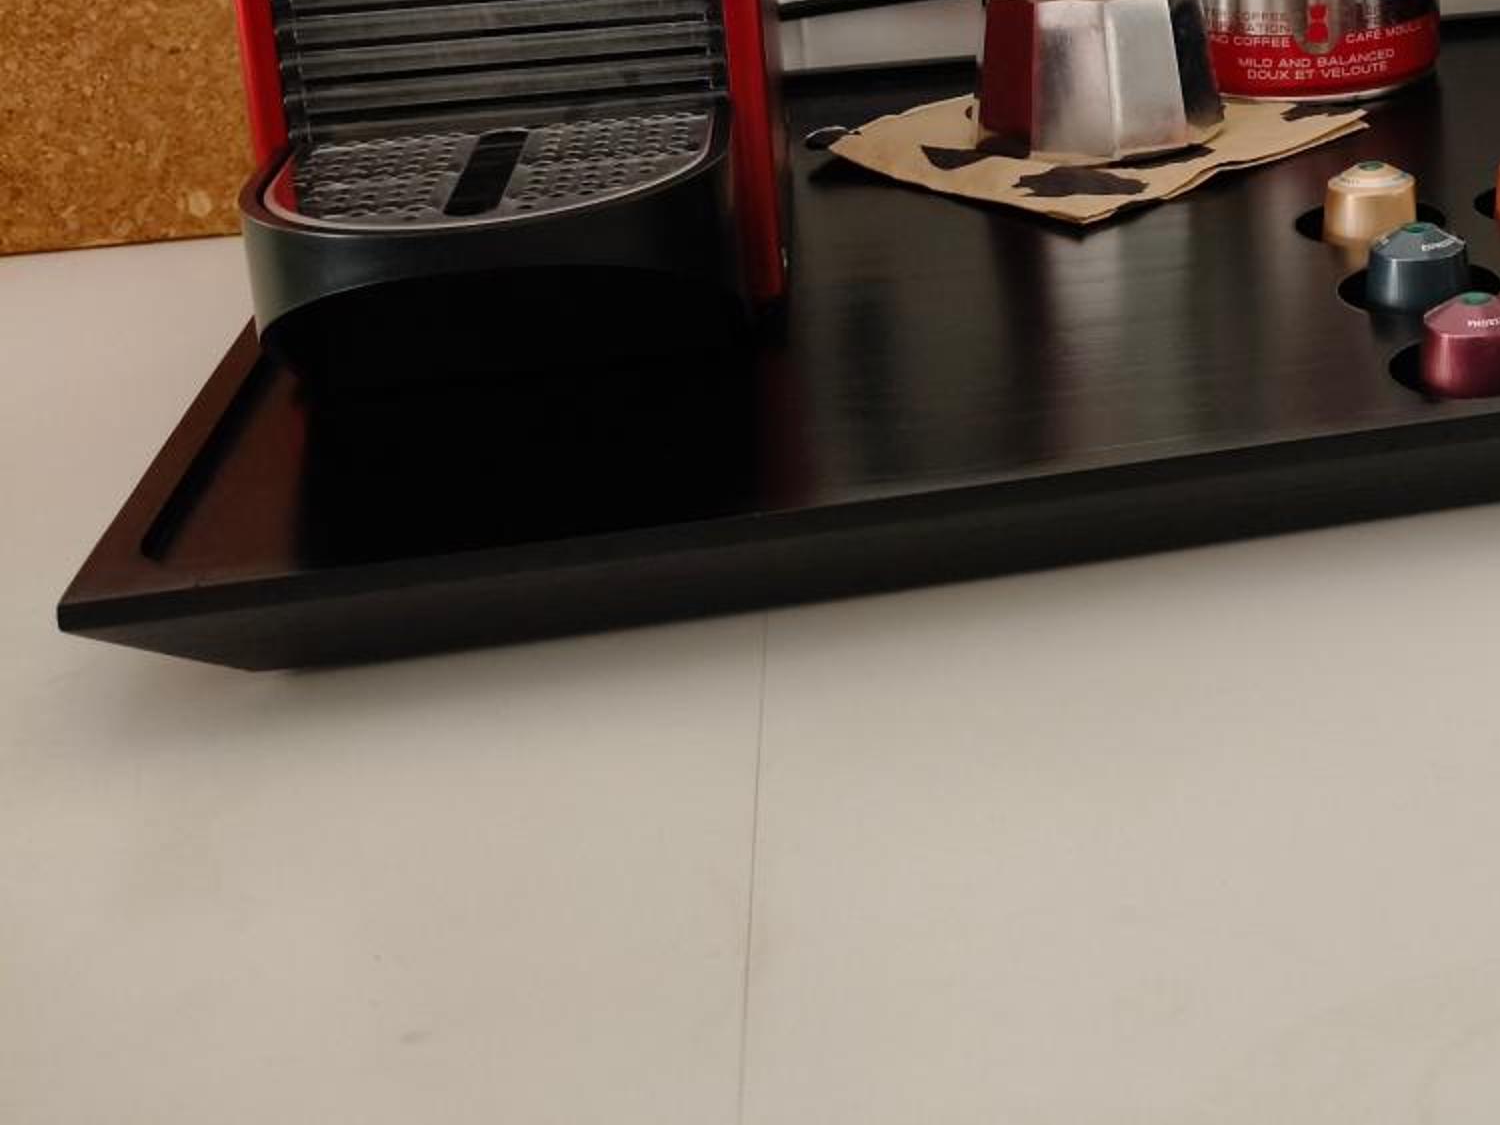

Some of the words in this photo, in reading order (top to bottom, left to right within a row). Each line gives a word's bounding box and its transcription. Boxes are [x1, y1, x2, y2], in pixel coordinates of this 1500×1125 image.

[1232, 35, 1292, 49] COFFEE
[1238, 56, 1273, 68] MILD
[1278, 58, 1311, 69] AND
[1317, 48, 1395, 68] BALANCED
[1247, 68, 1290, 81] DOUX
[1295, 69, 1315, 80] ET
